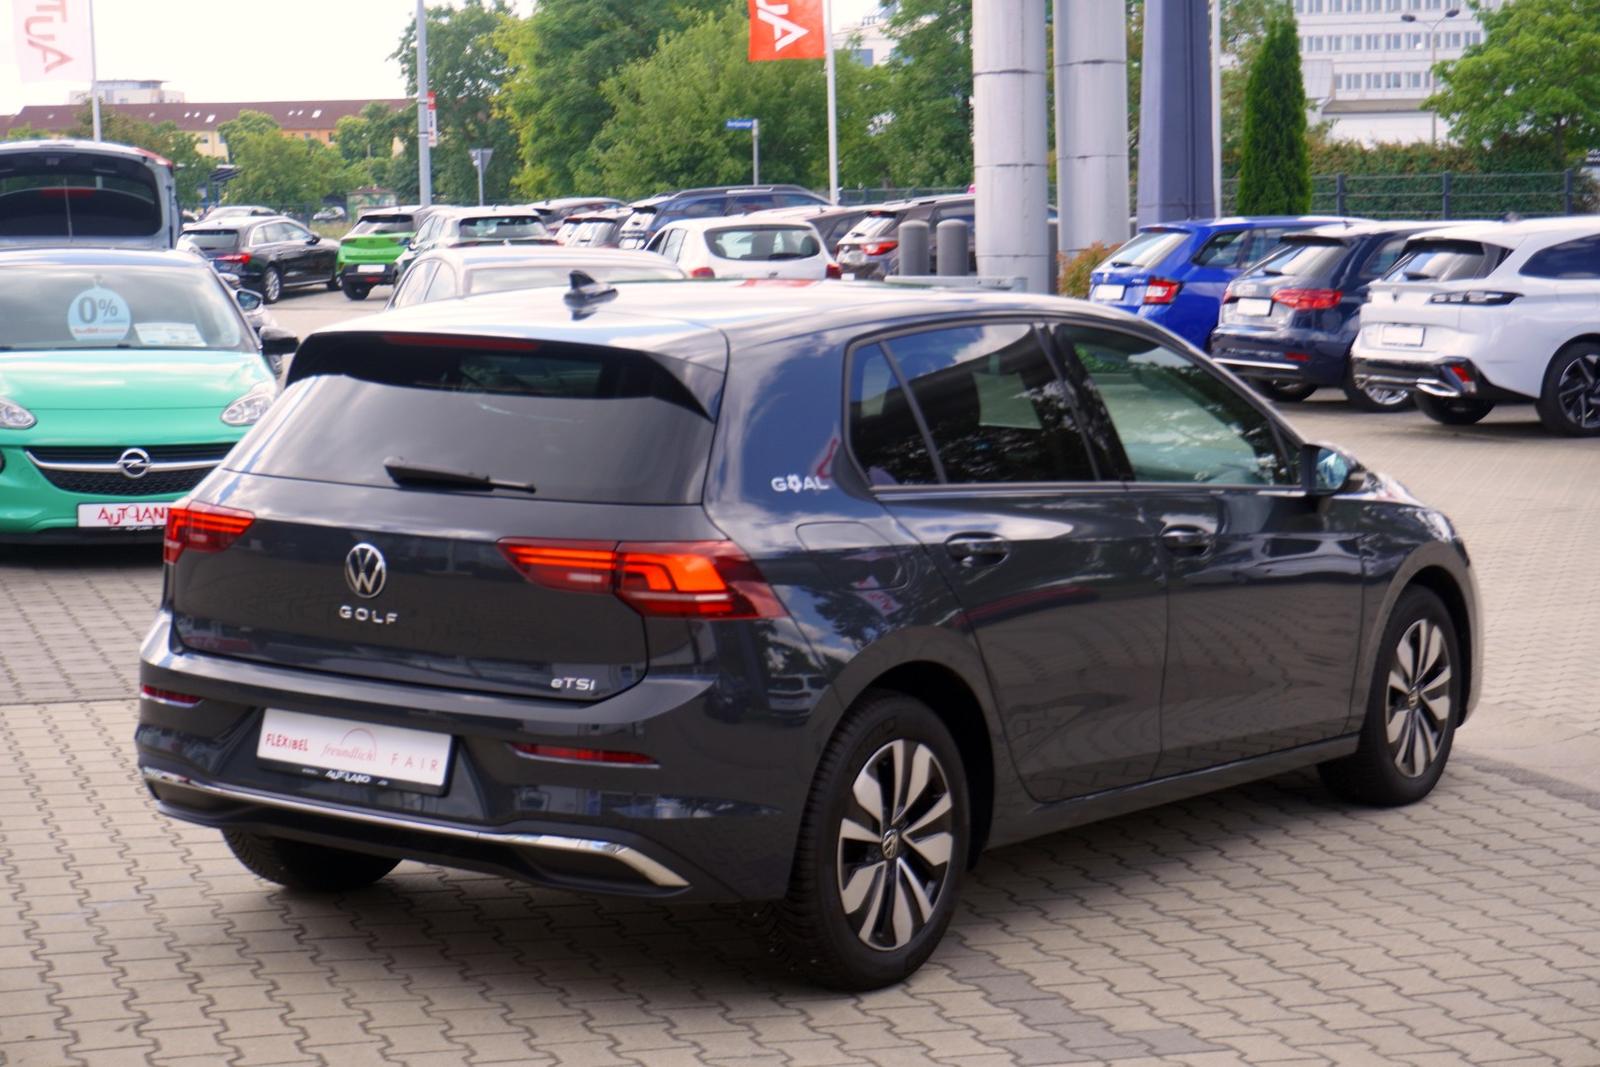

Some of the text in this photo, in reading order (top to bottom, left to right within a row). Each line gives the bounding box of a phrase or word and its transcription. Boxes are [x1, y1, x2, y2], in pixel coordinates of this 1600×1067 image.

[771, 474, 829, 493] GOAL
[97, 505, 169, 525] AUTOLAN
[339, 605, 398, 624] GOLF
[551, 677, 595, 691] eTSI
